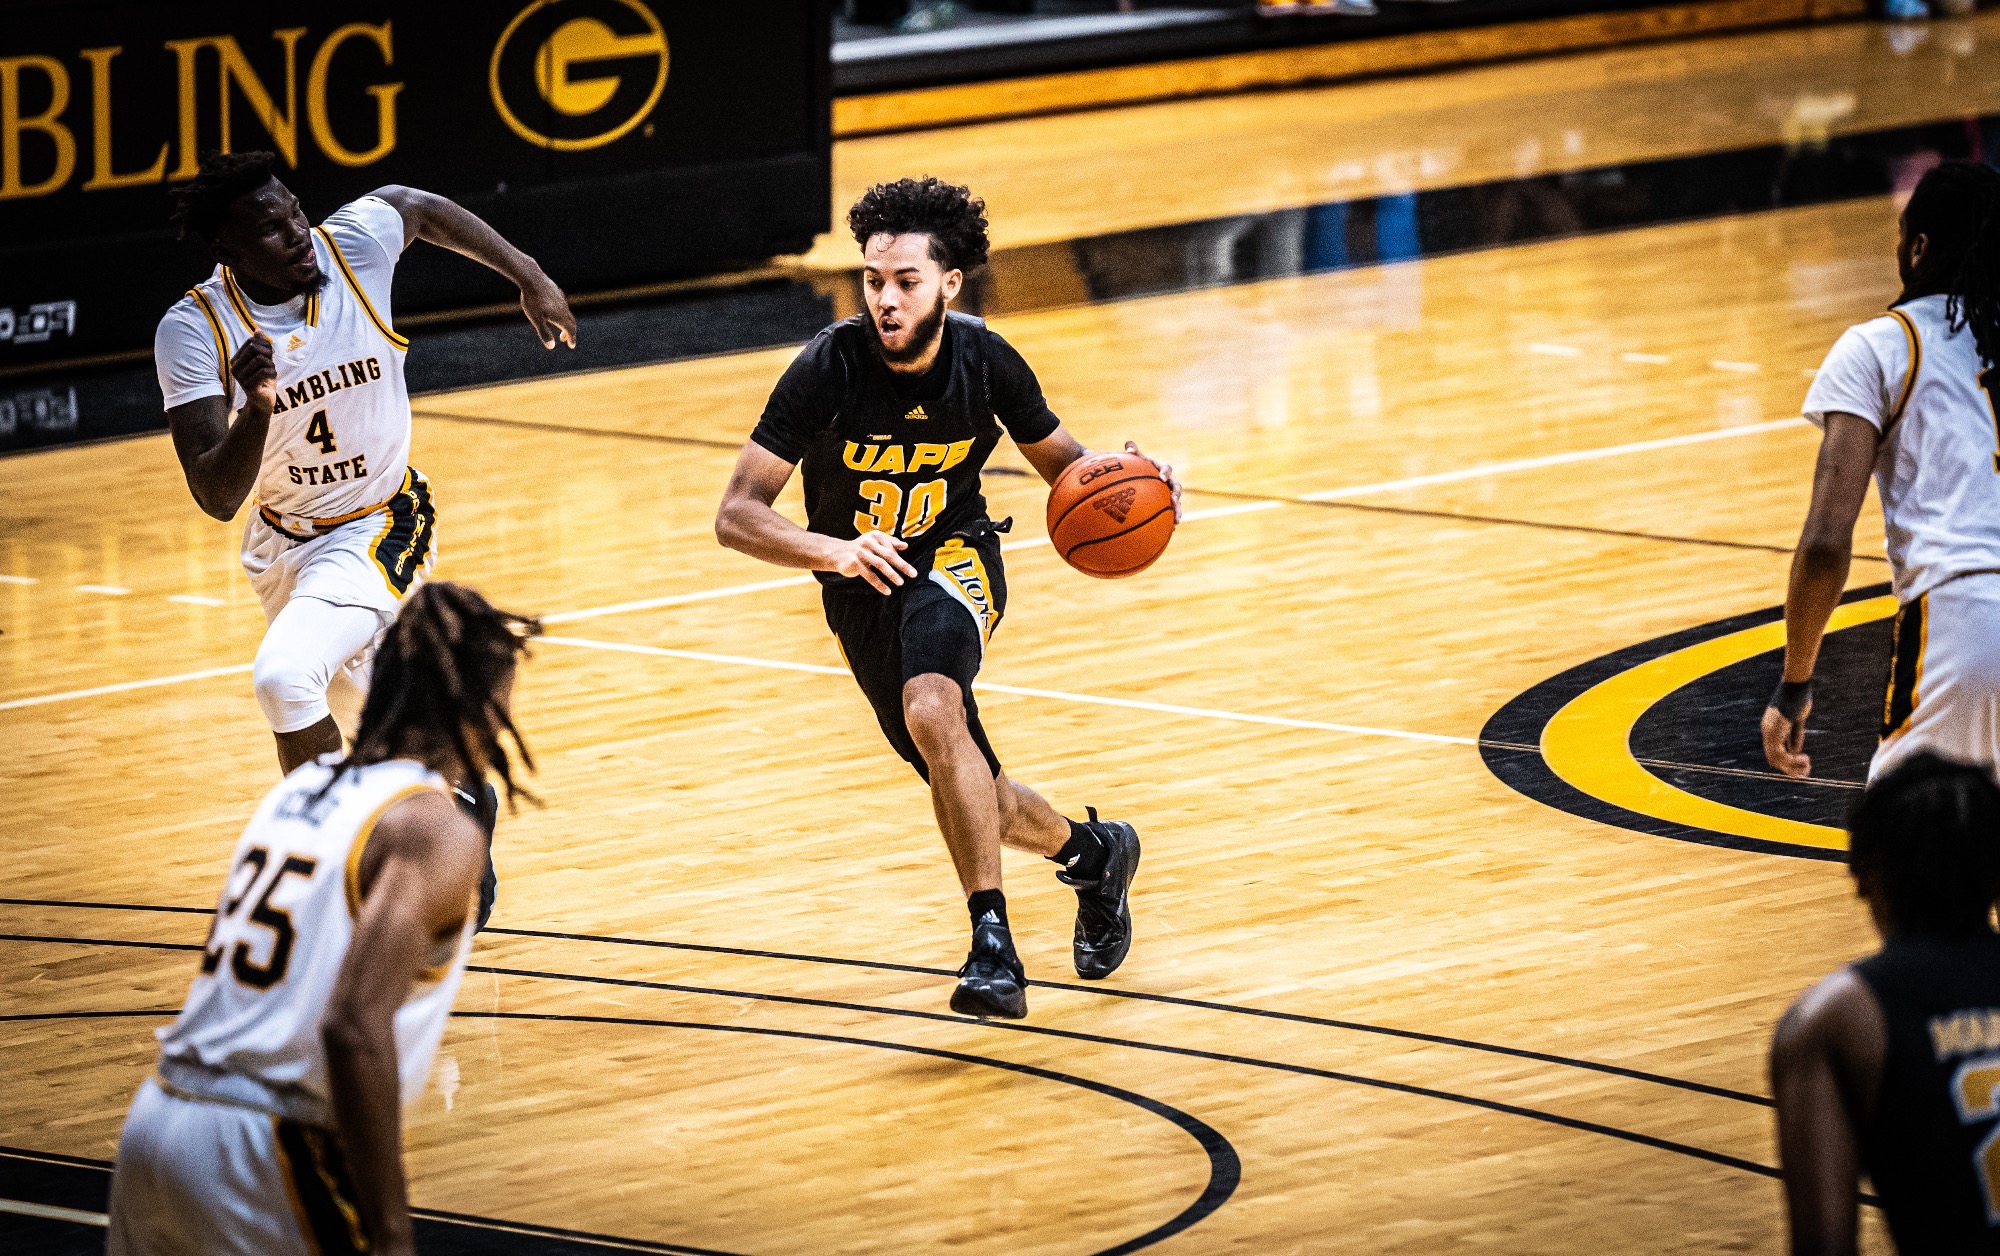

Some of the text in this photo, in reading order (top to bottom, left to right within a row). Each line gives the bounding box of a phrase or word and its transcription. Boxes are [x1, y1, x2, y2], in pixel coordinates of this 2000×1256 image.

[0, 20, 405, 199] BLING
[273, 357, 381, 414] AMBLING
[304, 408, 338, 455] 4
[842, 437, 976, 474] UAPB
[288, 454, 368, 486] STATE
[1079, 462, 1124, 485] PRO
[853, 478, 948, 539] 30
[202, 846, 319, 992] 25
